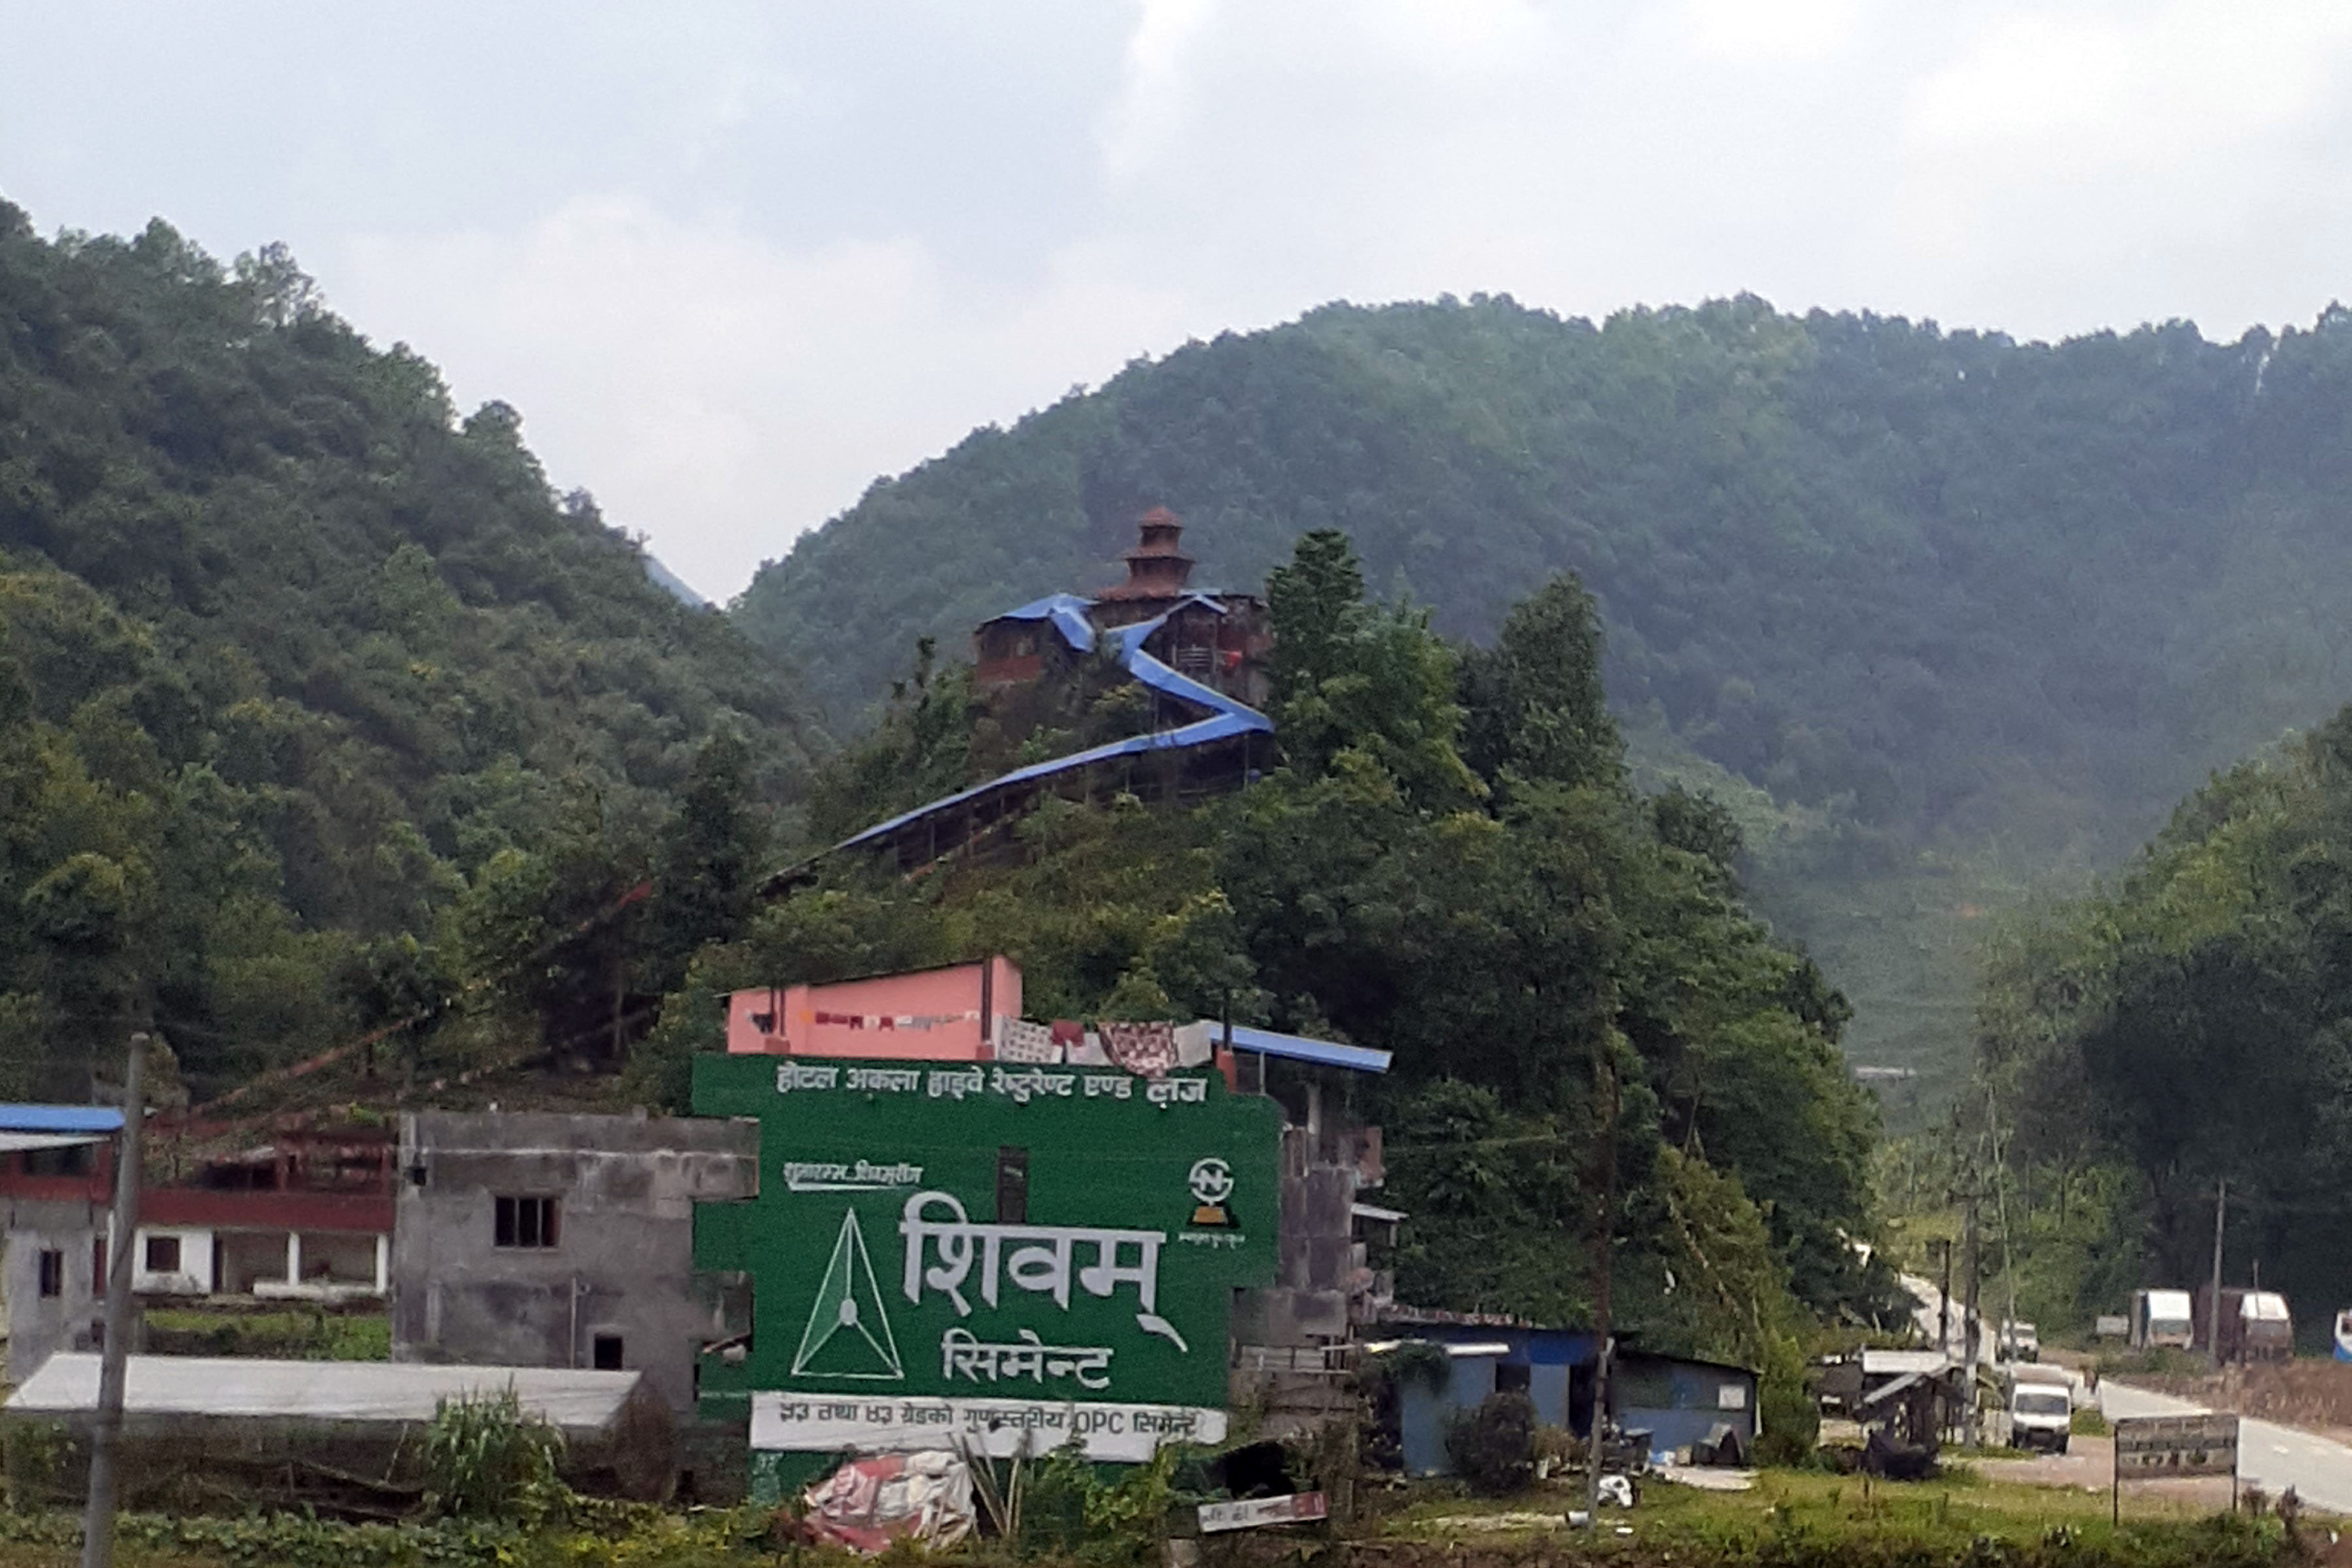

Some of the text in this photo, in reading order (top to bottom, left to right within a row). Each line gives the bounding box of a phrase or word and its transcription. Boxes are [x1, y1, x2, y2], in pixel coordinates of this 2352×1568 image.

[776, 1061, 839, 1093] होटल
[1083, 1075, 1134, 1099] एण्ड
[899, 1190, 1188, 1352] शिवम्
[941, 1327, 1114, 1389] सिमेन्ट
[818, 1403, 858, 1422] तथा
[1074, 1411, 1124, 1435] OPC
